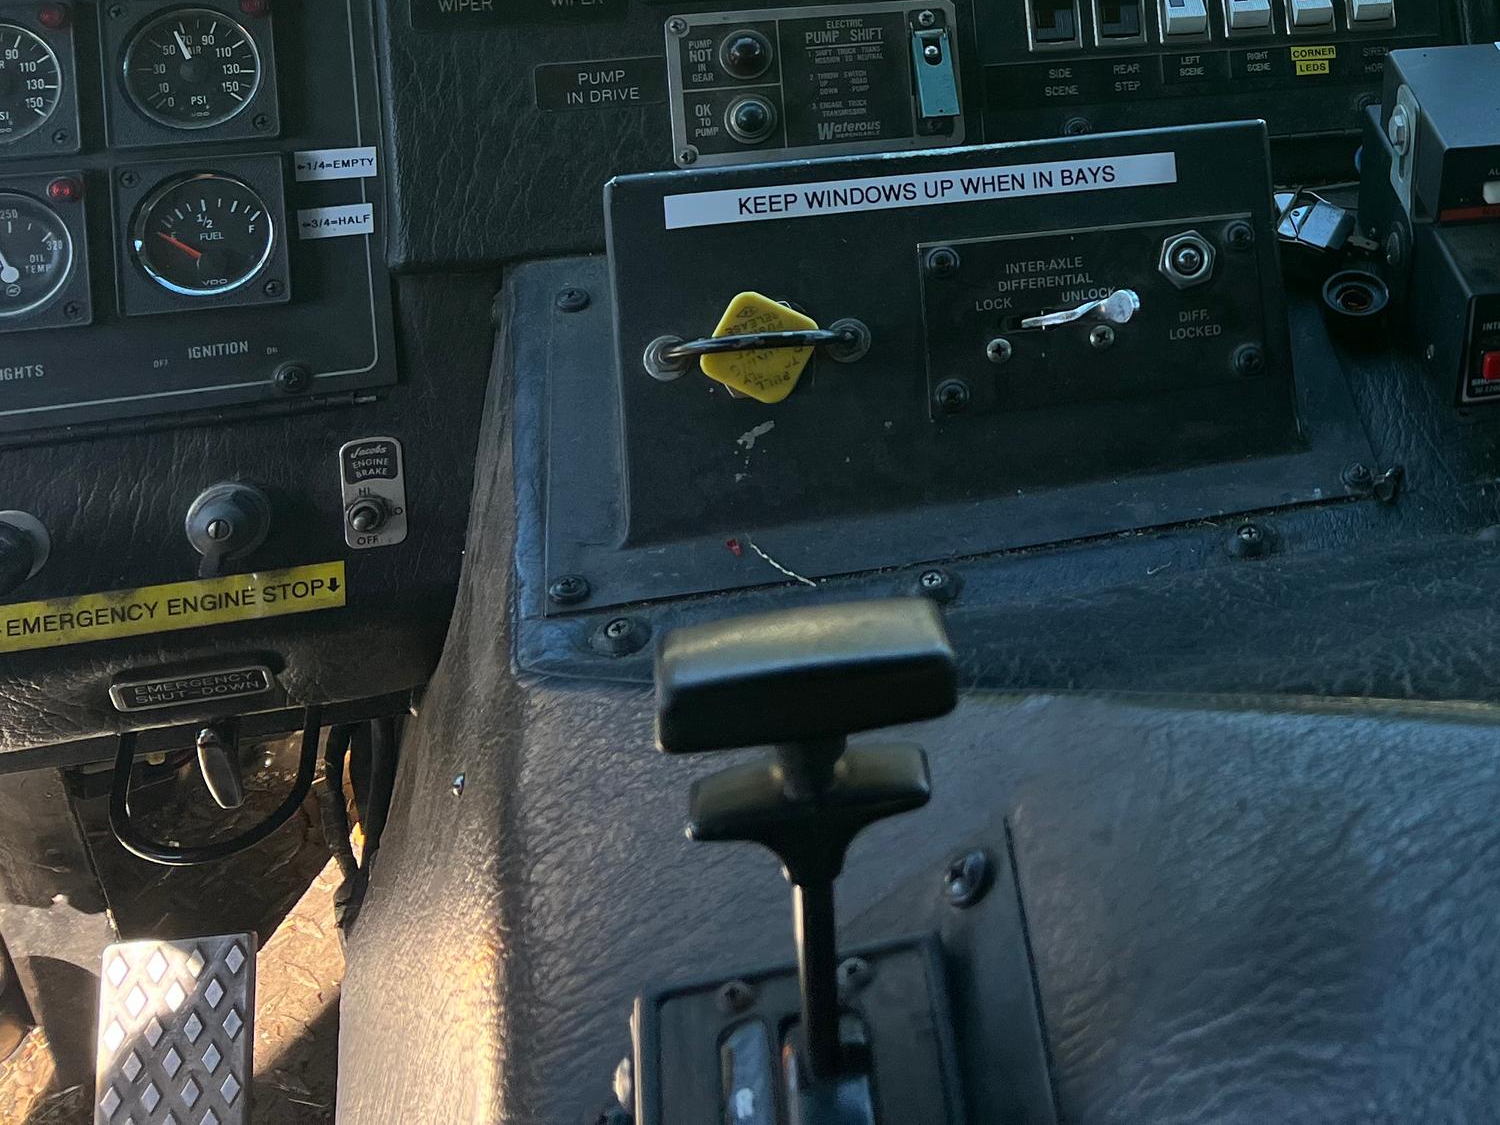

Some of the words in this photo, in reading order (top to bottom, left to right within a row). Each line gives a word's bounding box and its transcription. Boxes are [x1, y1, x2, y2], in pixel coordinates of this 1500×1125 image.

[826, 19, 863, 29] ELECTRIC
[181, 35, 193, 45] 70
[201, 35, 215, 45] 90
[805, 30, 840, 44] PUMP
[850, 28, 883, 41] SHIFT
[162, 44, 176, 56] 50
[187, 46, 201, 55] AIR
[689, 39, 712, 50] PUMP
[5, 48, 19, 60] 90
[216, 47, 232, 58] 110
[689, 49, 713, 62] NOT
[1247, 50, 1269, 61] RIGHT
[1292, 47, 1335, 59] CORNER
[1363, 46, 1389, 58] SIREN
[1181, 56, 1200, 66] LEFT
[1247, 61, 1272, 72] SCENE
[1300, 61, 1327, 73] LEDS
[20, 62, 37, 73] 110
[153, 63, 166, 74] 30
[222, 63, 240, 75] 130
[697, 63, 706, 73] IN
[1049, 67, 1073, 79] SIDE
[1113, 63, 1140, 75] REAR
[1179, 66, 1205, 76] SCENE
[1364, 62, 1384, 74] HOR
[578, 70, 626, 85] PUMP
[692, 72, 714, 83] GEAR
[26, 78, 45, 90] 130
[159, 82, 169, 93] 10
[222, 81, 239, 93] 150
[1114, 80, 1142, 92] STEP
[566, 91, 584, 104] IN
[590, 87, 641, 103] DRIVE
[1044, 85, 1079, 97] SCENE
[25, 97, 43, 109] 150
[167, 97, 175, 107] 0
[190, 95, 207, 105] PSI
[695, 104, 712, 117] OK
[700, 118, 711, 127] TO
[695, 127, 719, 137] PUMP
[818, 121, 881, 141] Waterous
[738, 192, 798, 215] KEEP
[804, 182, 916, 209] WINDOWS
[924, 178, 954, 199] UP
[960, 172, 1025, 196] WHEN
[1033, 170, 1054, 189] IN
[1060, 164, 1116, 186] BAYS
[0, 209, 18, 220] 250
[248, 225, 255, 234] F
[199, 231, 225, 241] FUEL
[46, 240, 63, 251] 320
[29, 254, 45, 263] OIL
[25, 264, 51, 274] TEMP
[1005, 256, 1083, 275] INTER-AXLE
[202, 278, 228, 286] VDO
[998, 272, 1093, 292] DIFFERENTIAL
[1061, 285, 1116, 302] UNLOCK
[975, 297, 1013, 312] LOCK
[1178, 309, 1211, 322] DIFF.
[1169, 324, 1222, 341] LOCKED
[187, 340, 249, 360] IGNITION
[266, 346, 278, 356] ON
[350, 444, 388, 459] Jacobs
[352, 458, 389, 469] ENGINE
[356, 467, 388, 478] BRAKE
[358, 487, 370, 496] HI
[357, 536, 378, 546] OFF
[6, 600, 159, 637] EMERGENCY
[167, 588, 256, 617] ENGINE
[263, 578, 325, 603] STOP
[134, 671, 253, 695] EMERGENCY
[135, 681, 260, 704] SHUT-DOWN
